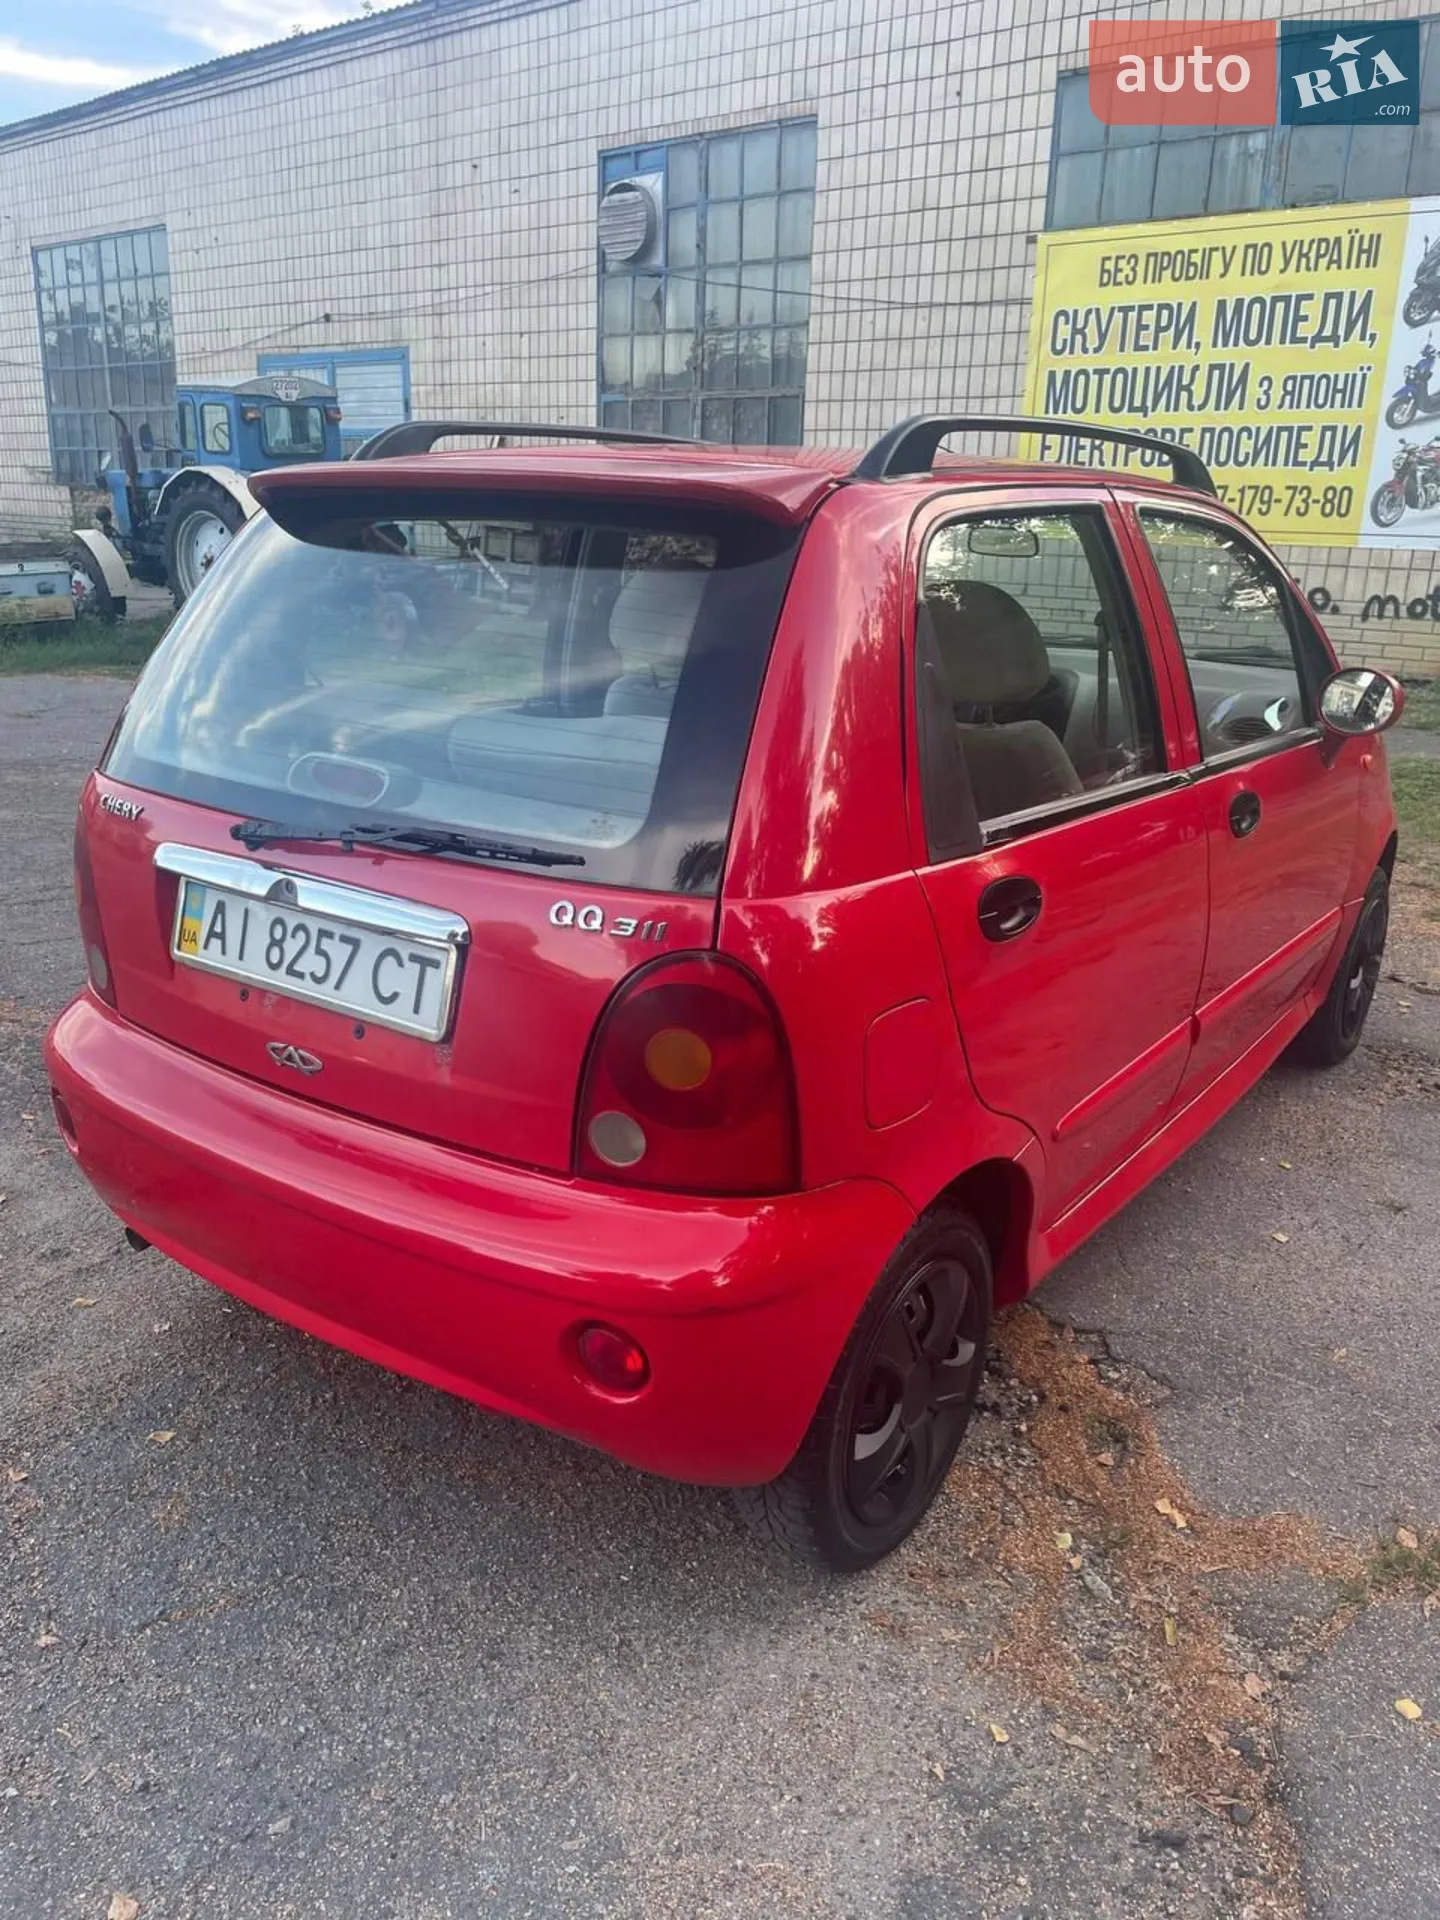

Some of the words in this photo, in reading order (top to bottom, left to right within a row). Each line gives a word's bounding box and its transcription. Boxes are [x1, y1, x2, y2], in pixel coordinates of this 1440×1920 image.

[1098, 253, 1139, 288] БЕЗ
[1143, 245, 1237, 285] ПРОБІГУ
[1240, 242, 1273, 277] ПО
[1279, 228, 1382, 274] УКРАЇНІ
[1050, 301, 1201, 356] СКУТЕРИ,
[1211, 289, 1378, 349] МОПЕДИ,
[1044, 361, 1251, 418] МОТОЦИКЛИ
[1277, 365, 1372, 411] ЯПОНІЇ
[100, 793, 144, 821] CHERY
[182, 929, 197, 945] UA
[549, 900, 605, 932] QQ
[609, 917, 668, 942] 311
[203, 900, 249, 961] AI
[265, 916, 361, 991] 8257
[372, 947, 441, 1015] CT
